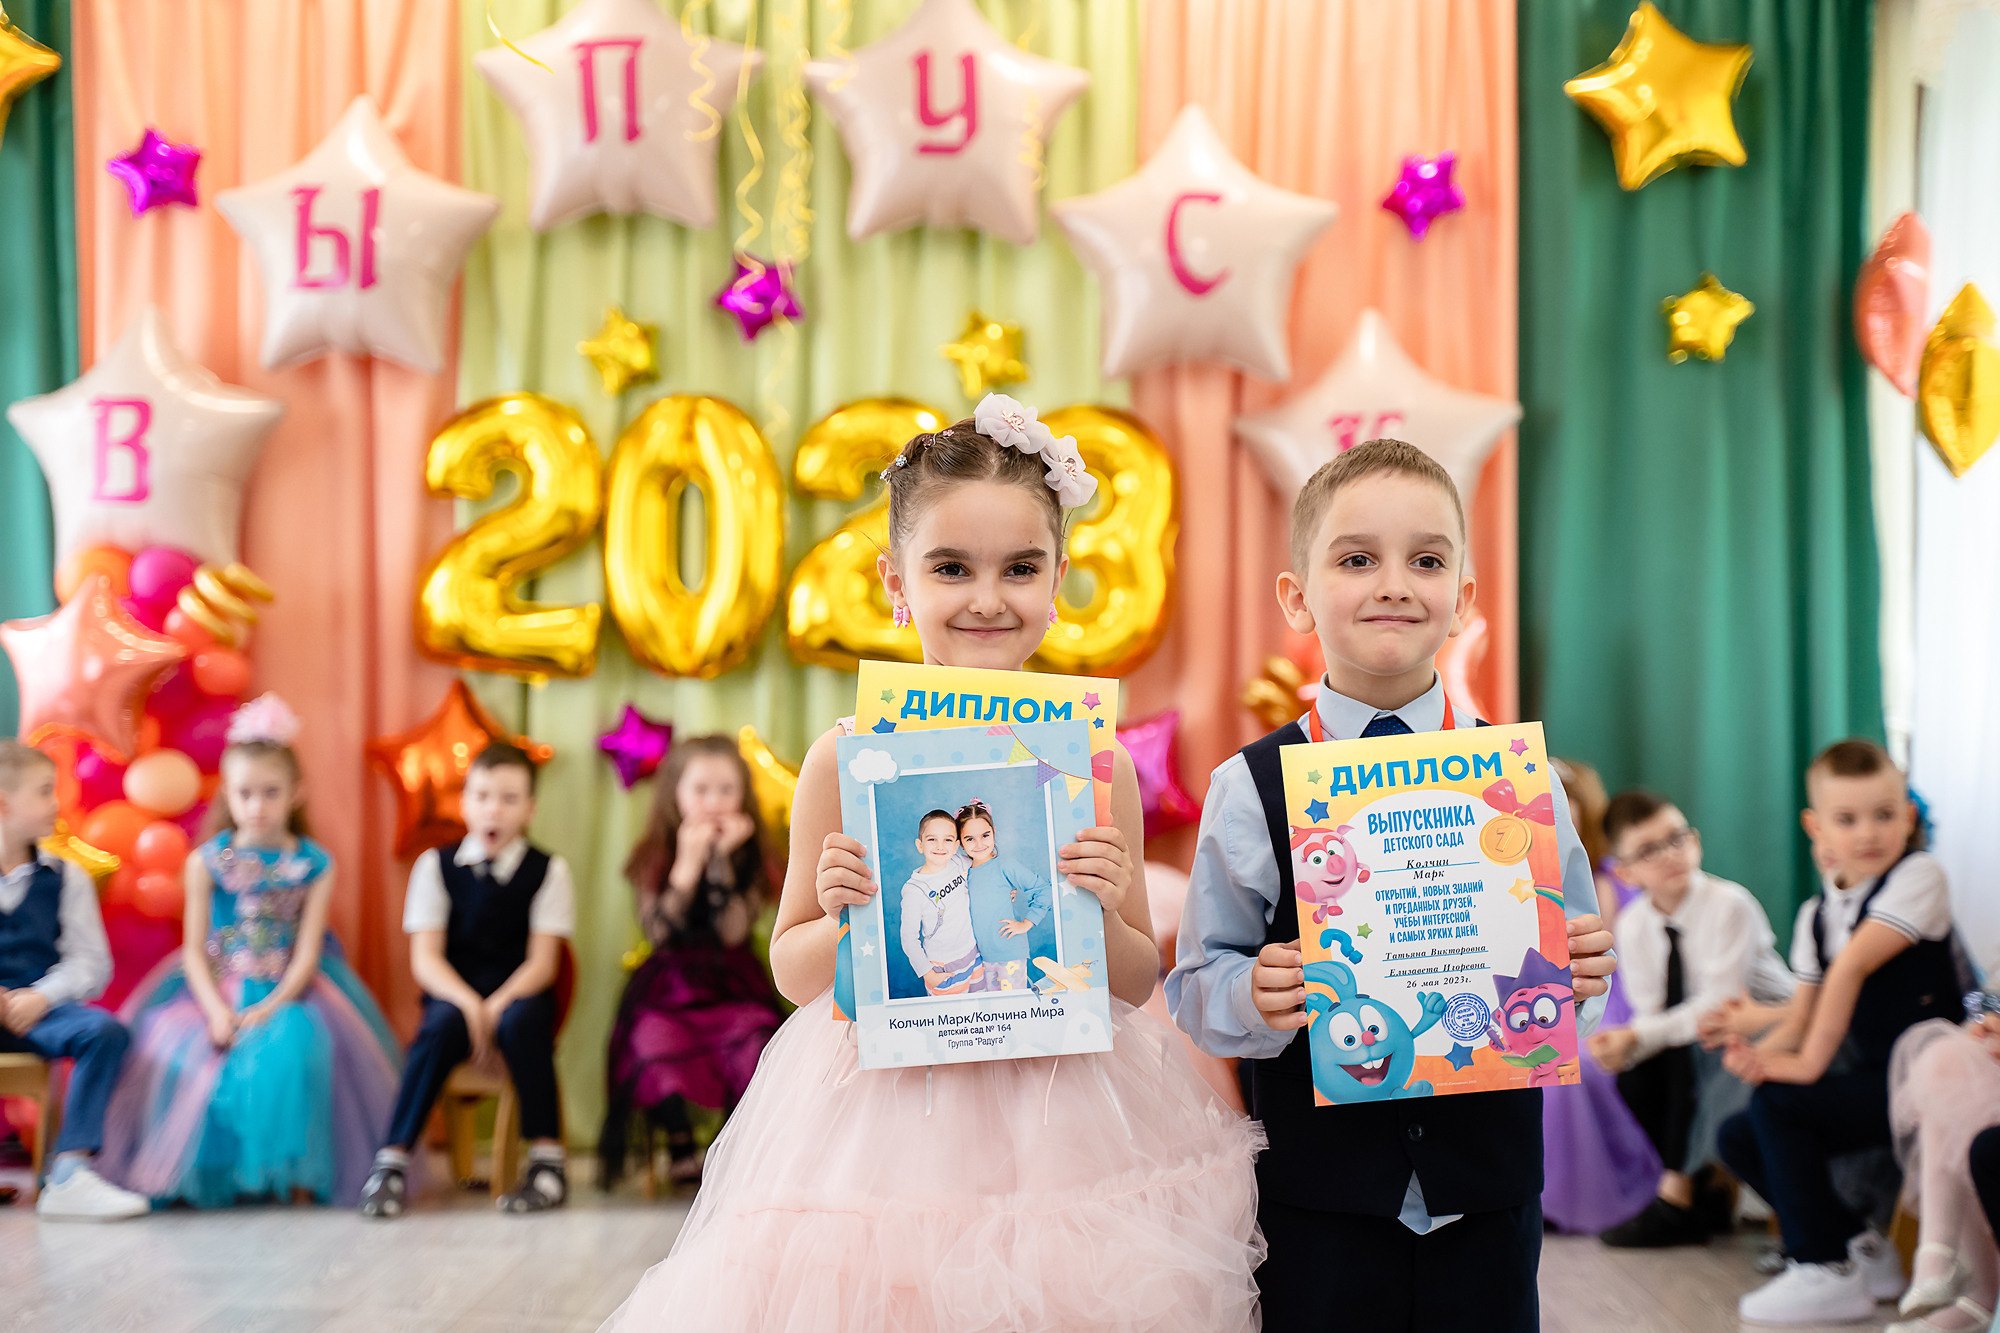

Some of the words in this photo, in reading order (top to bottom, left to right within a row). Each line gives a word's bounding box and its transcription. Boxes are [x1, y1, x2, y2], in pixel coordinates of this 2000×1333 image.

[415, 392, 1178, 678] 2023
[900, 689, 1072, 724] ДИПЛОМ
[1330, 752, 1503, 797] ДИПЛОМ
[1367, 804, 1475, 835] ВЫПУСКНИКА
[1383, 834, 1433, 854] ДЕТСКОГО
[1436, 831, 1464, 848] САДА
[1406, 859, 1449, 870] Колчин
[1413, 870, 1445, 881] Марк
[1375, 885, 1421, 902] ОТКРЫТИЙ,
[1422, 884, 1451, 898] НОВЫХ
[1452, 879, 1484, 895] ЗНАНИЙ
[1385, 903, 1391, 915] И
[1392, 899, 1441, 915] ПРЕДАННЫХ
[1443, 895, 1477, 911] ДРУЗЕЙ,
[1394, 914, 1421, 929] УЧЁБЫ
[1422, 909, 1471, 926] ИНТЕРЕСНОЙ
[1389, 932, 1396, 943] И
[1397, 929, 1426, 943] САМЫХ
[1427, 926, 1453, 940] ЯРКИХ
[1455, 923, 1479, 938] ДНЕЙ!
[1385, 951, 1427, 961] Татьяна
[1431, 945, 1486, 956] Викторовна
[1389, 966, 1439, 977] Елизавета
[1442, 962, 1486, 973] Игоревна
[1406, 980, 1417, 989] 26
[1421, 980, 1439, 988] мая
[1443, 975, 1472, 986] 2023г.
[889, 1017, 935, 1030] Колчин
[1030, 1006, 1065, 1019] Мира
[938, 1026, 969, 1038] детский
[970, 1025, 985, 1036] сад
[997, 1023, 1011, 1032] 164
[948, 1038, 974, 1049] Группа
[975, 1035, 1006, 1047] "Радуга"
